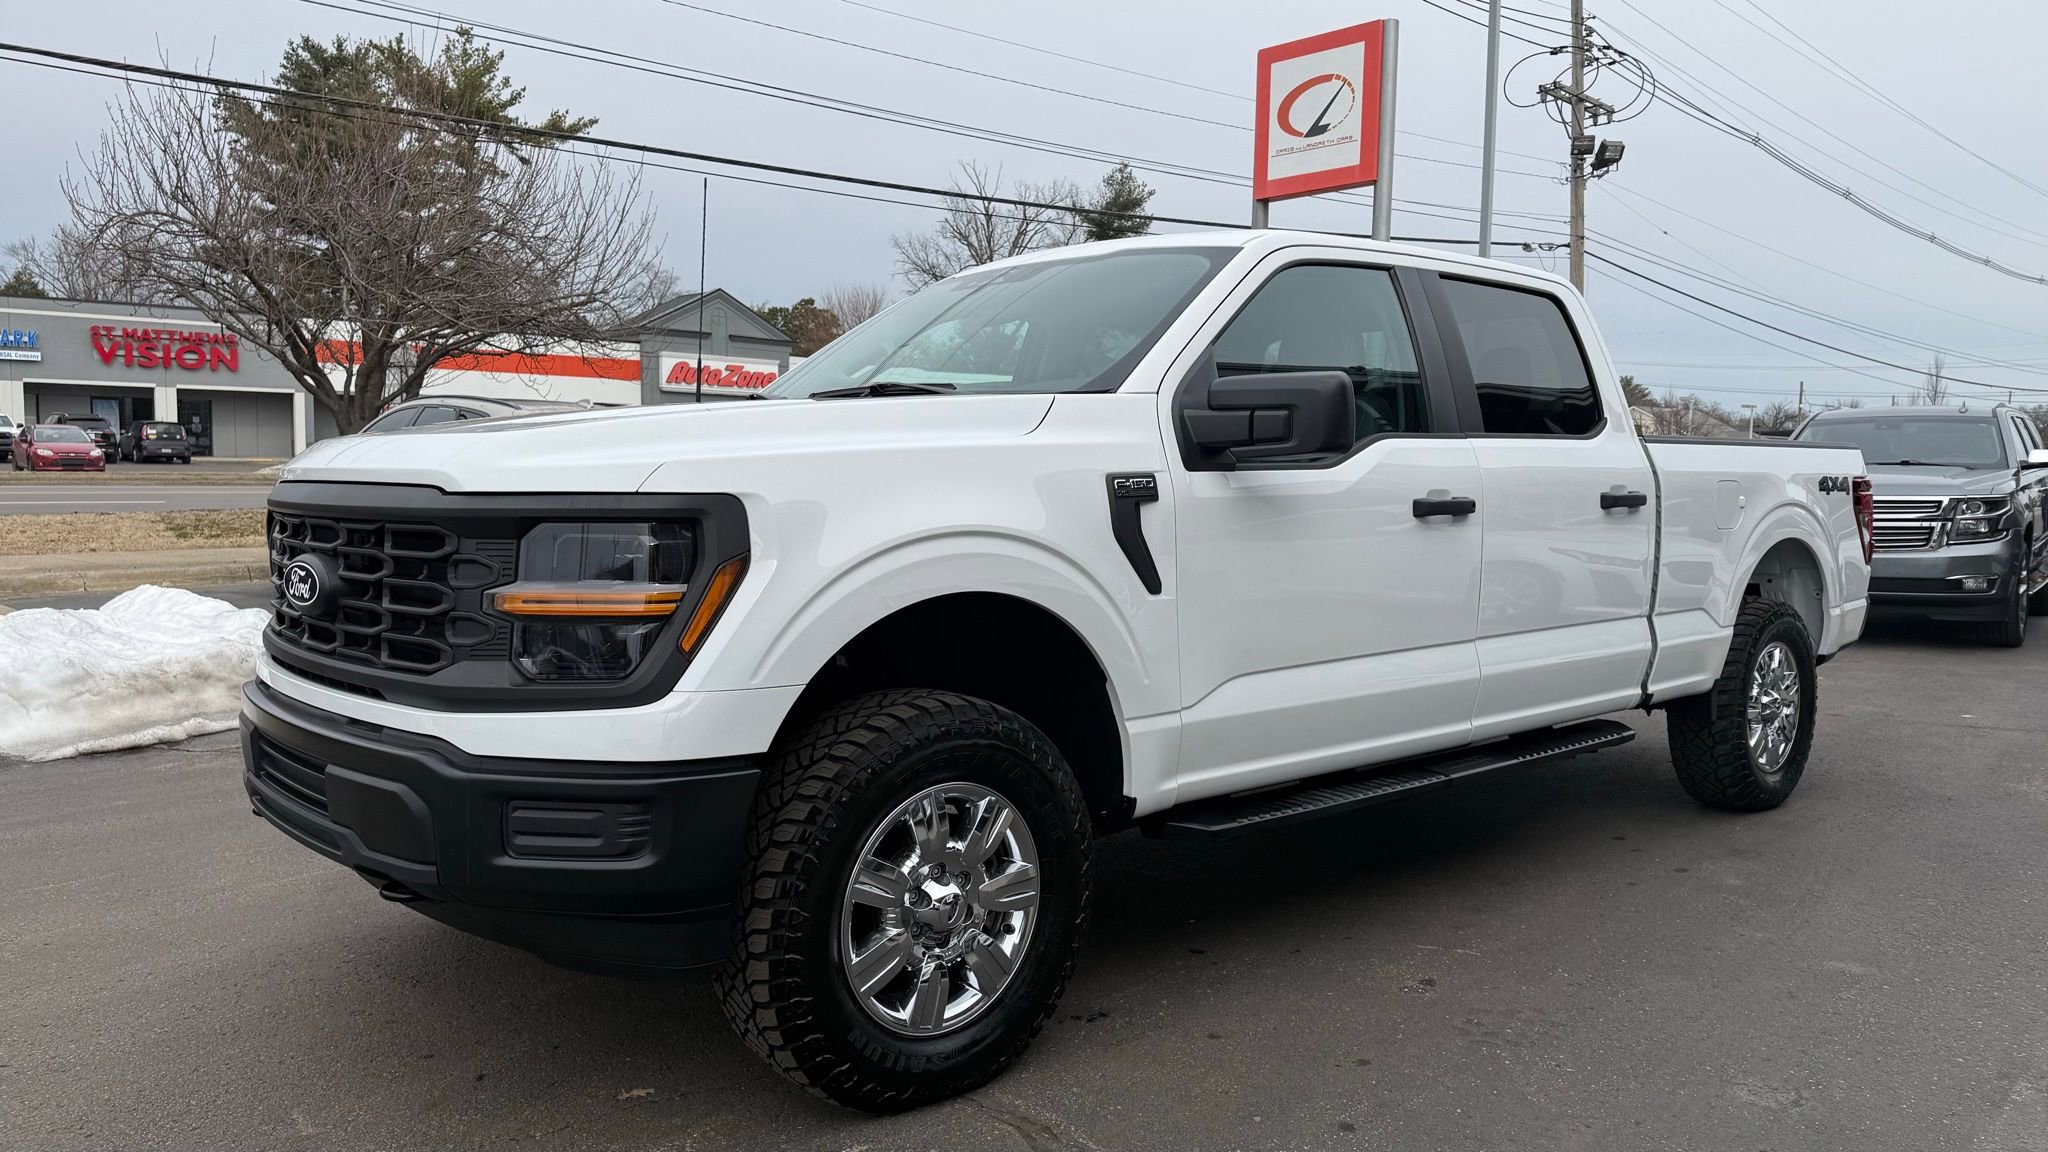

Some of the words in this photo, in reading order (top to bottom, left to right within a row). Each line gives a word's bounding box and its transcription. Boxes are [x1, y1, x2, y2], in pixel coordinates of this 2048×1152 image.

[121, 327, 239, 346] MATTHEWS
[92, 339, 239, 373] VISION
[666, 361, 777, 388] AutoZone
[1114, 478, 1154, 489] F-150
[288, 567, 312, 600] Ford
